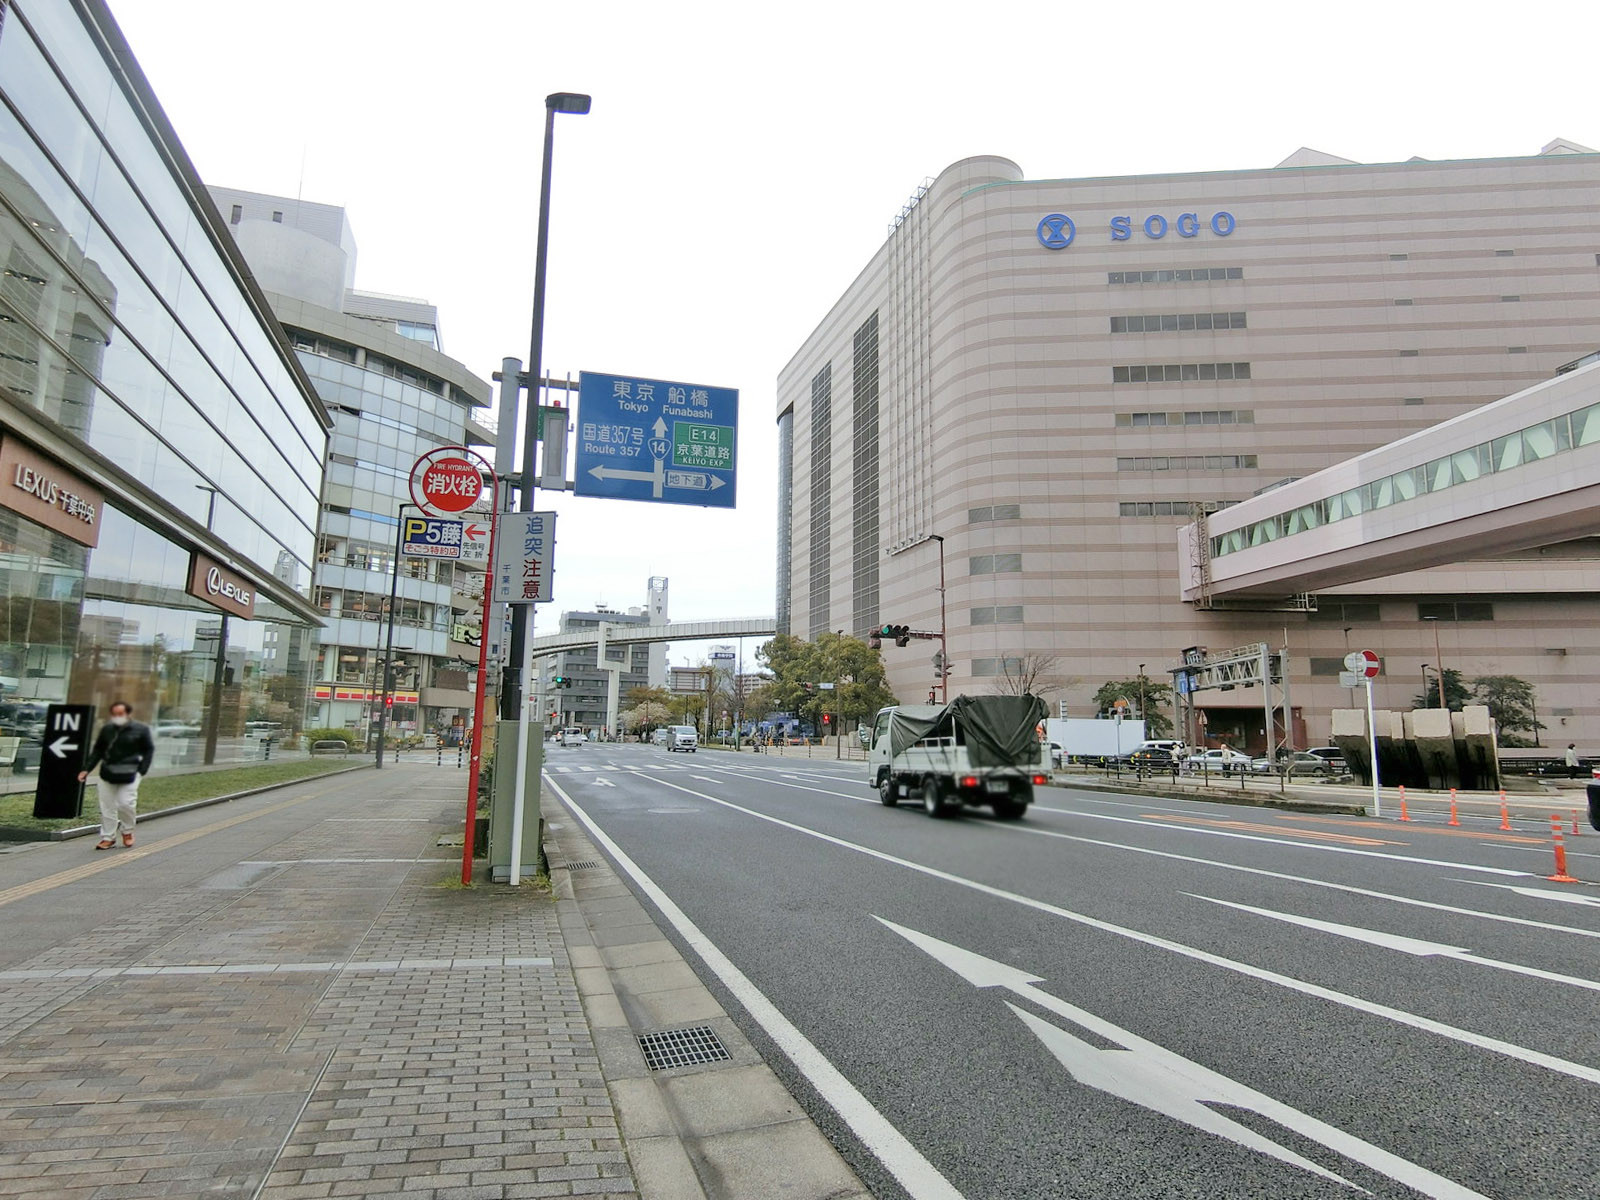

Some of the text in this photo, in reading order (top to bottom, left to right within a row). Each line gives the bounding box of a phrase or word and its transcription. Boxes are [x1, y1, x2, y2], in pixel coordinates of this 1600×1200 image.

[1109, 211, 1236, 241] SOGO
[612, 381, 709, 407] 東京 船橋
[618, 400, 713, 419] Tokyo Funabashi
[583, 422, 644, 446] 国道357号
[692, 429, 717, 441] E14
[585, 443, 641, 457] Route 357
[652, 441, 666, 454] 14
[677, 443, 730, 460] 京葉道路
[433, 463, 474, 472] FIRE HYDRANT
[682, 456, 724, 467] KEIYO EXP
[427, 472, 478, 497] 消火栓
[669, 474, 704, 487] 地下道
[14, 463, 96, 525] LEXUS 千葉中央
[522, 516, 544, 599] 追突注意
[220, 578, 250, 606] LEXUS
[54, 712, 81, 731] IN
